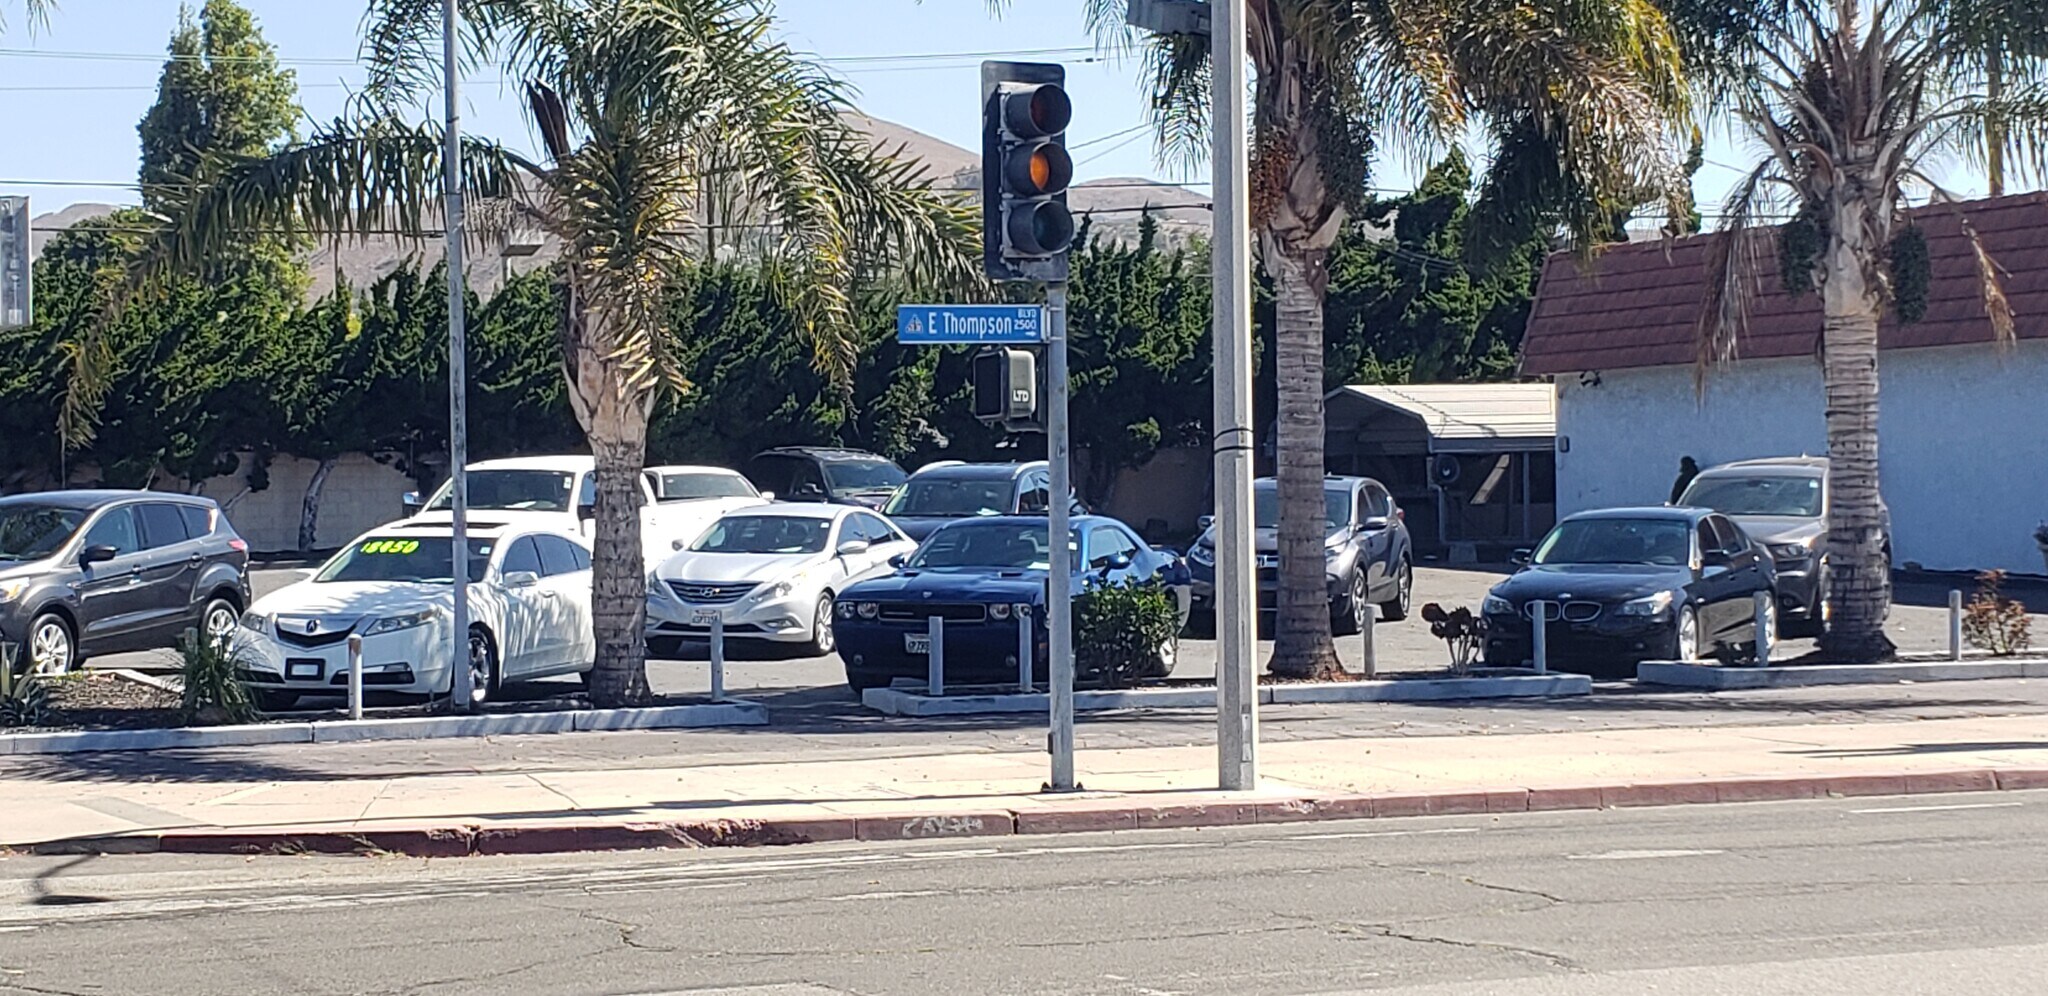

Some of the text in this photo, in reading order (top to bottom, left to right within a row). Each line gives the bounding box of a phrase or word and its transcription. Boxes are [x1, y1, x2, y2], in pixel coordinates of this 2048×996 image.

[1017, 308, 1037, 318] BLVD
[928, 311, 1012, 339] E Thompson
[1014, 319, 1037, 330] 2500
[1012, 389, 1029, 402] LTD
